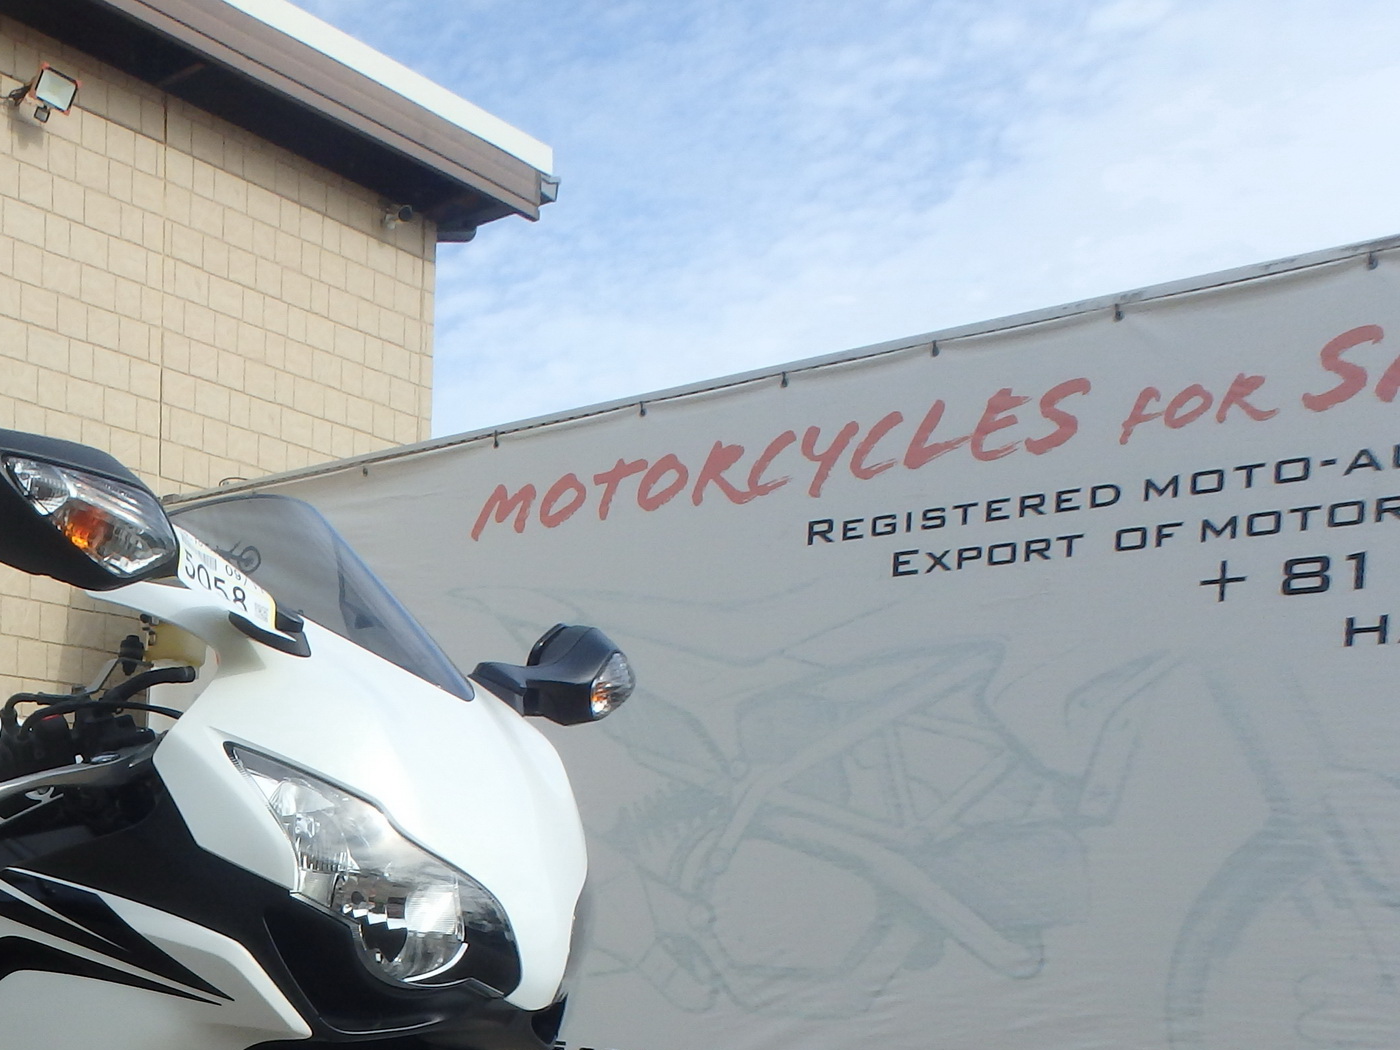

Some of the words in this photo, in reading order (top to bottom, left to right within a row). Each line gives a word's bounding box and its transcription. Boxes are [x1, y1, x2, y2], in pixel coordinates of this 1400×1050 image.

[471, 377, 1091, 541] MOTORCYCLES
[1119, 373, 1280, 445] FOR
[806, 484, 1121, 545] REGISTERED
[1143, 444, 1400, 501] MOTO-A
[892, 533, 1084, 577] EXPORT
[1115, 522, 1183, 551] OF
[1280, 551, 1367, 596] 81
[1343, 614, 1400, 647] H
